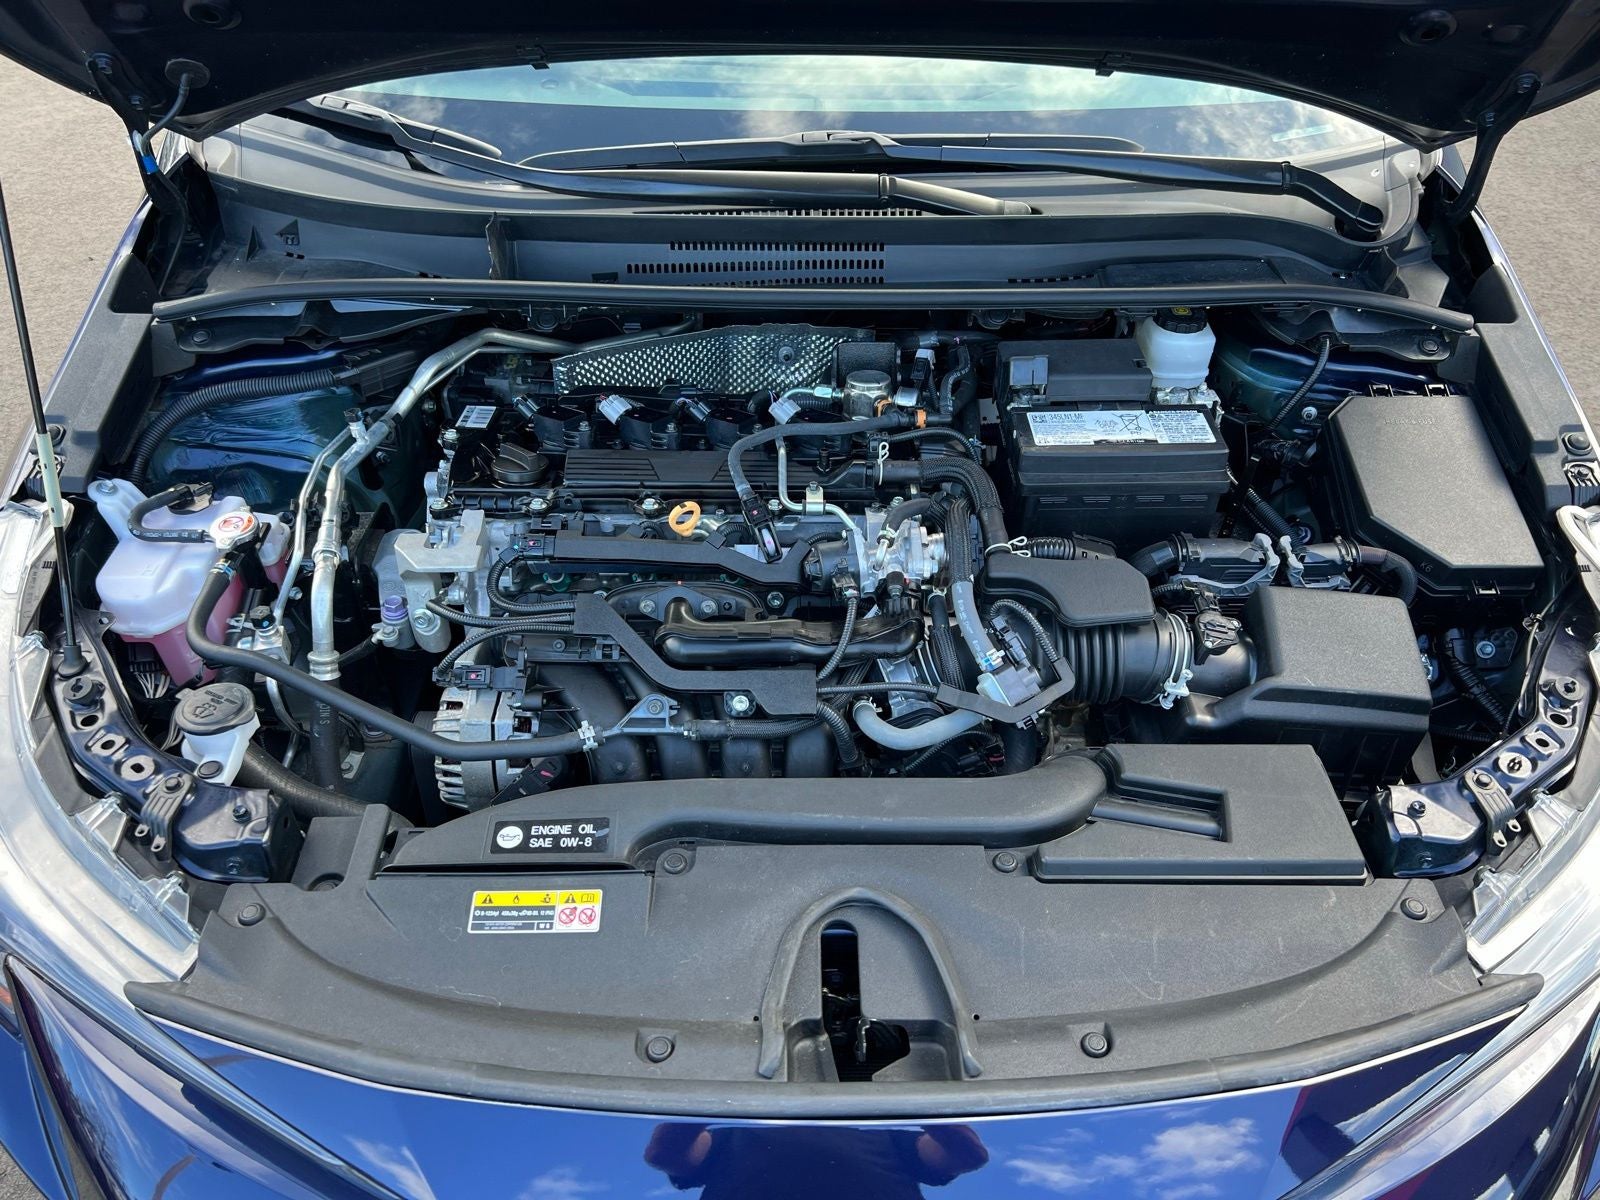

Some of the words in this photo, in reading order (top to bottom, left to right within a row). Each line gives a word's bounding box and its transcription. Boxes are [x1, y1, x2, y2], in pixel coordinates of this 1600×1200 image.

[530, 824, 573, 835] ENGINE
[578, 823, 597, 834] OIL
[528, 837, 554, 848] SAE
[559, 836, 593, 848] 0W-8
